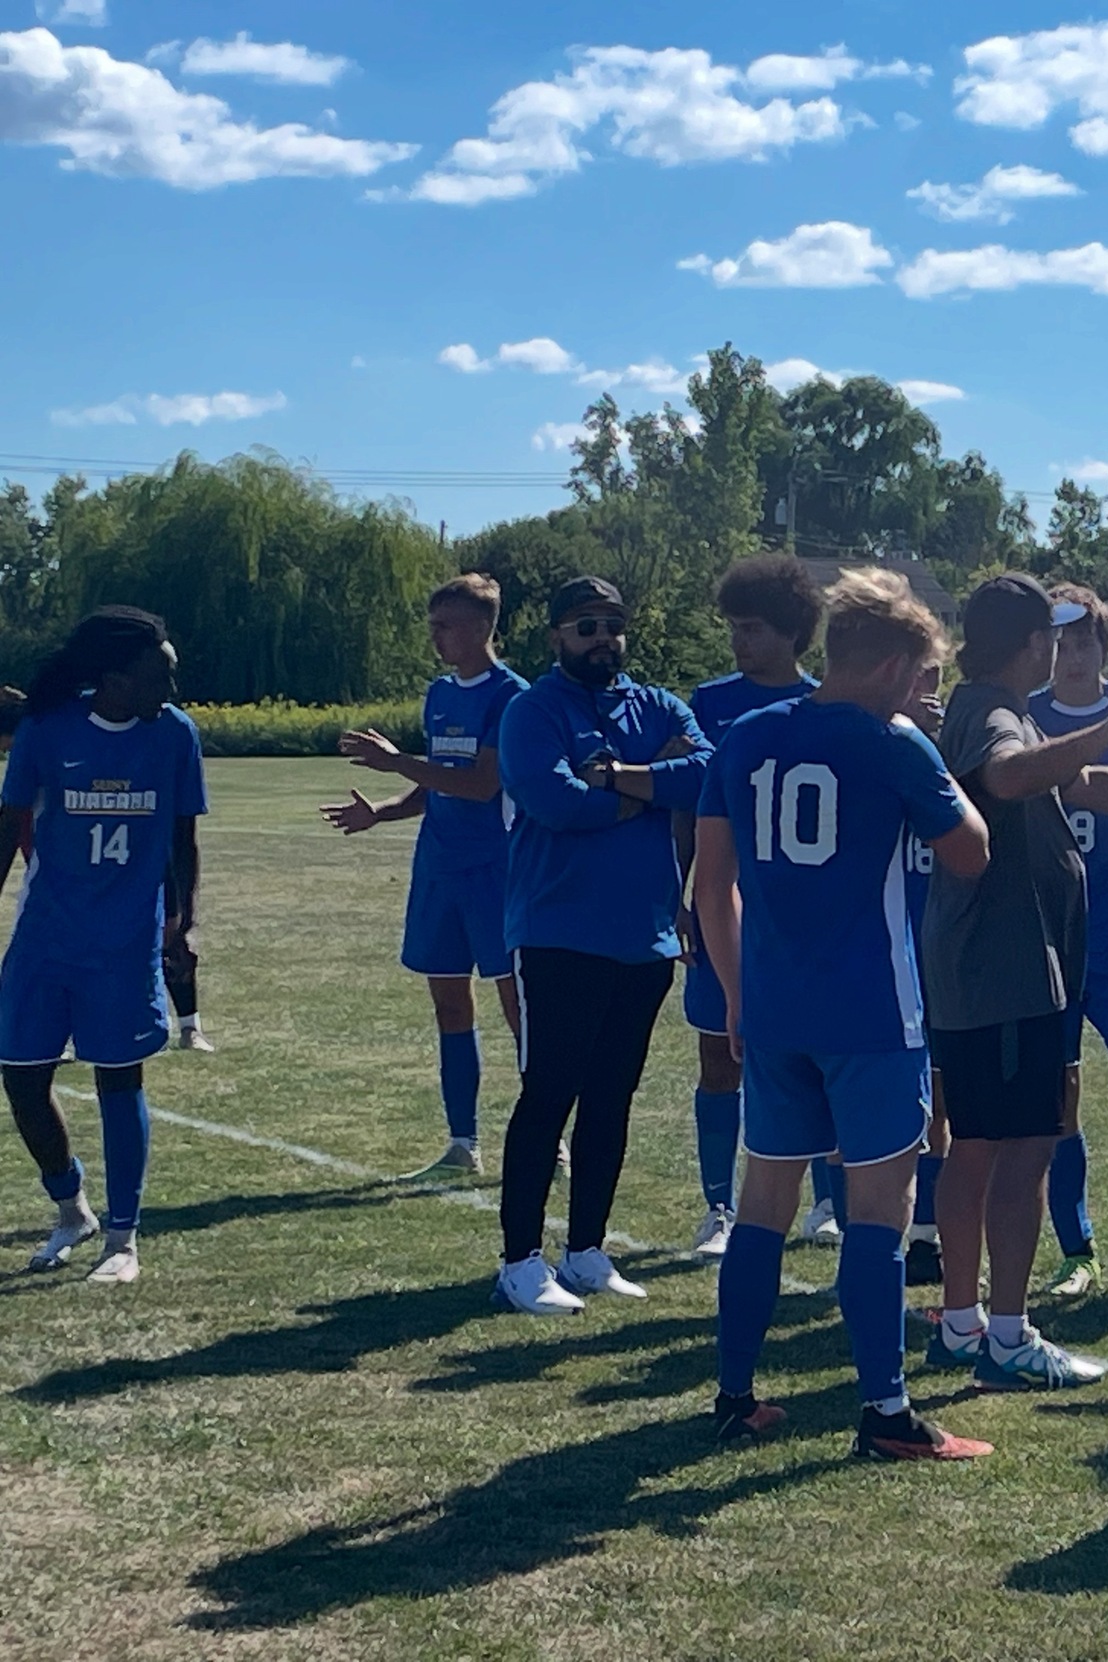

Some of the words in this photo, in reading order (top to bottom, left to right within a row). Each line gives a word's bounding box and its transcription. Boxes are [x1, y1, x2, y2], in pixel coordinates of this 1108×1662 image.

[750, 759, 838, 866] 10
[1069, 811, 1095, 853] 8
[90, 822, 130, 865] 14
